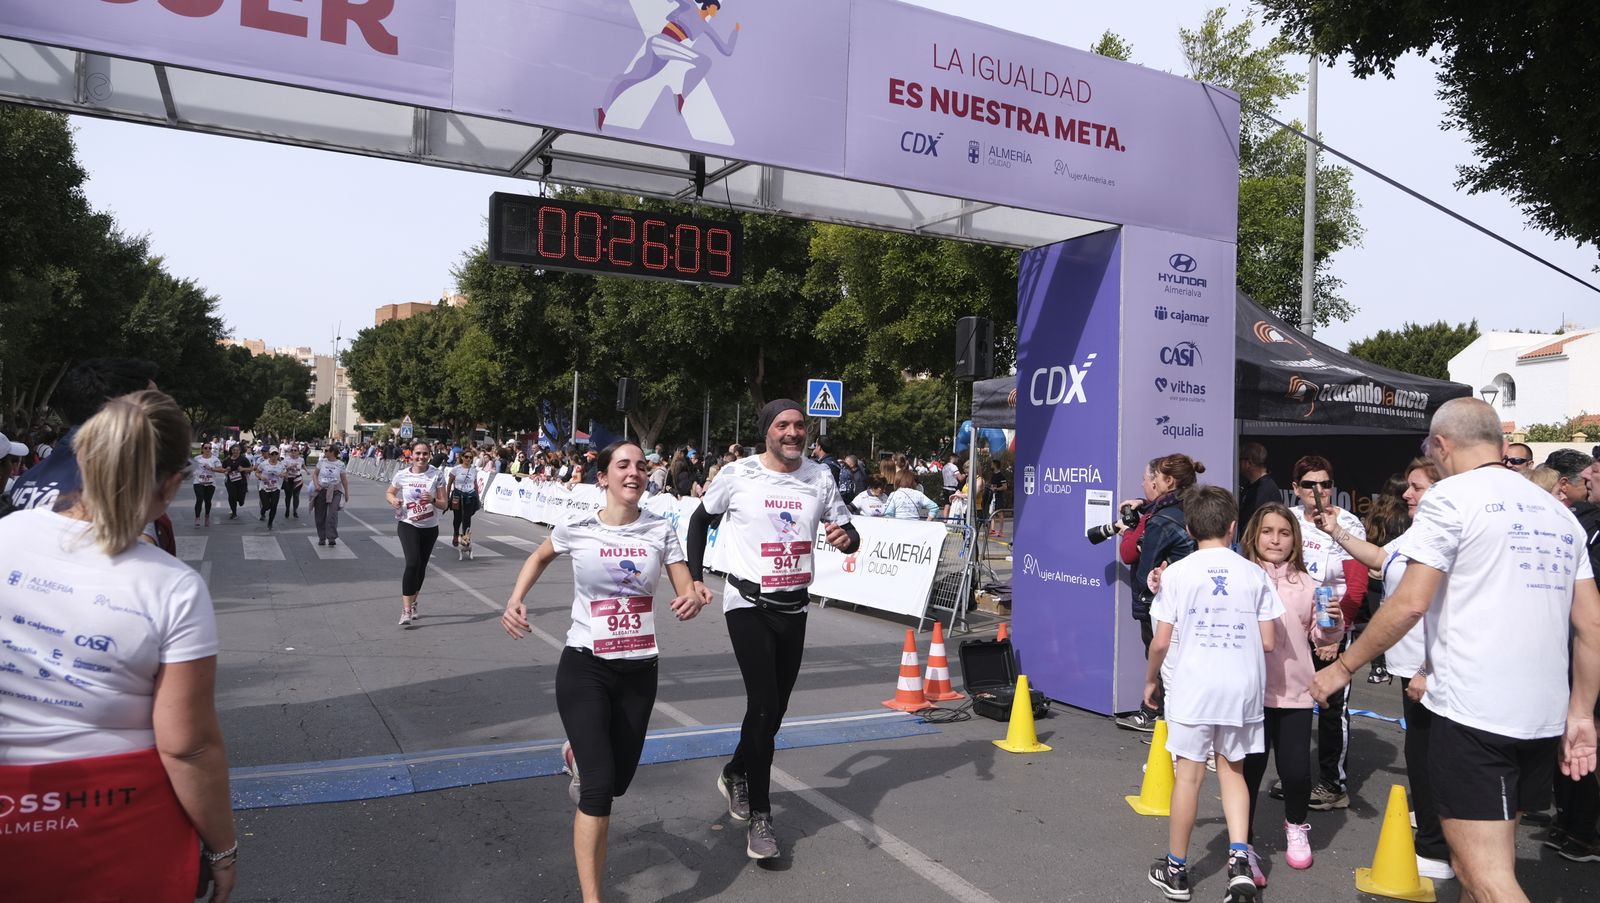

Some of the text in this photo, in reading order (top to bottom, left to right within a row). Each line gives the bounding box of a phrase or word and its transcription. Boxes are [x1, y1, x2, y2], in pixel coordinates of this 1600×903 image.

[932, 43, 1092, 104] LA IGUALDAD
[888, 77, 1126, 152] ES NUESTRA META.
[900, 130, 944, 158] CDX
[987, 157, 1011, 169] CIUDAD
[988, 145, 1033, 165] ALMERÍA
[536, 205, 731, 278] 00:26:09
[1158, 272, 1207, 288] HYUNDAI
[1164, 285, 1202, 298] Almerialva
[1170, 310, 1209, 323] cajamar
[1160, 345, 1195, 367] CASI
[1029, 353, 1098, 407] CDX
[1170, 381, 1206, 394] vithas
[1162, 422, 1204, 439] aqualia
[1043, 464, 1102, 484] ALMERÍA
[1043, 483, 1072, 495] CIUDAD
[764, 499, 803, 510] MUJER
[1485, 501, 1506, 513] CDX
[599, 548, 648, 557] MUJER
[869, 541, 932, 566] ALMERÍA
[773, 556, 801, 570] 947
[867, 561, 899, 577] CIUDAD
[30, 576, 74, 594] ALMERÍA
[27, 619, 65, 635] cajamar
[607, 614, 642, 632] 943
[6, 644, 37, 655] aqualia
[74, 635, 110, 652] CASI
[42, 697, 84, 708] ALMERÍA
[0, 816, 79, 835] LMERÍA
